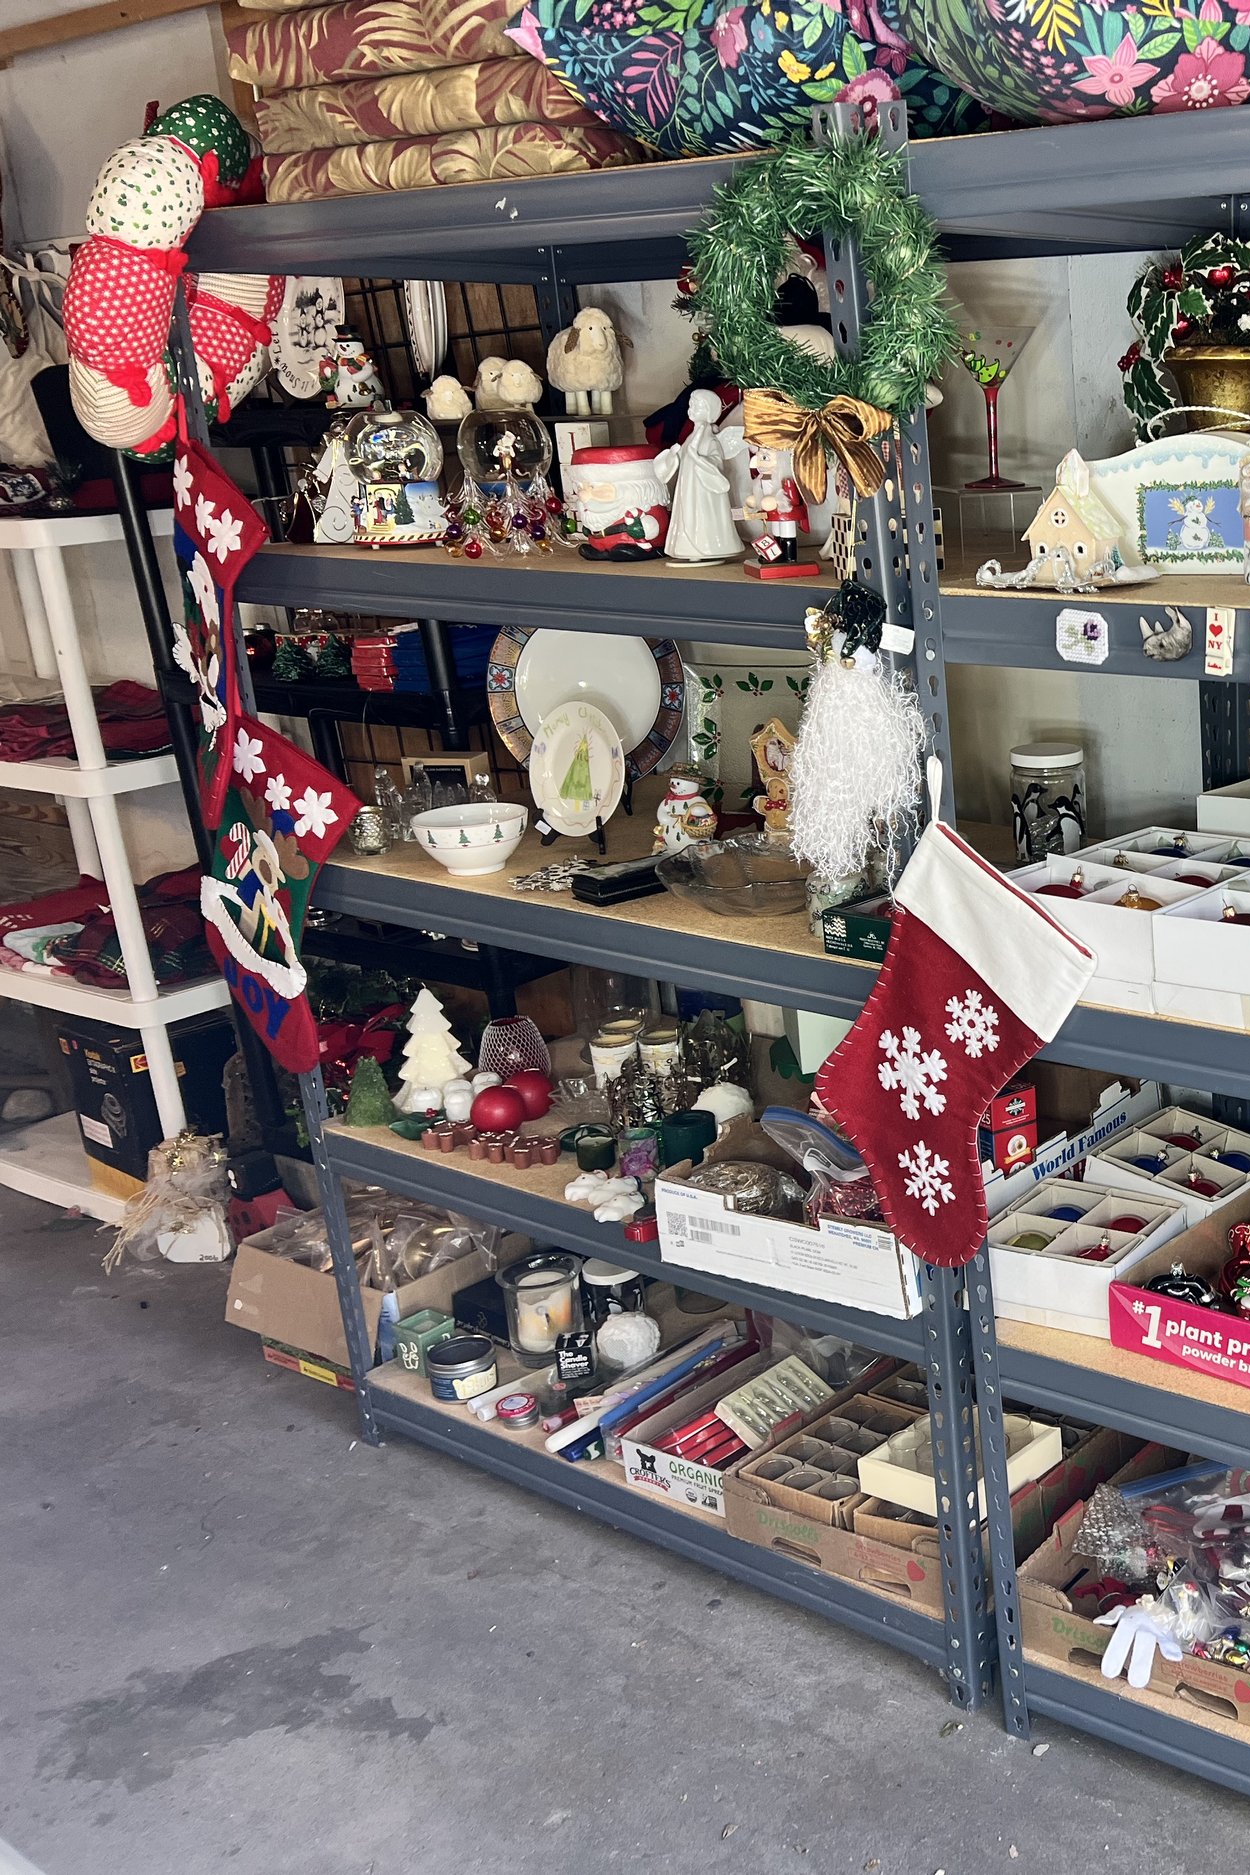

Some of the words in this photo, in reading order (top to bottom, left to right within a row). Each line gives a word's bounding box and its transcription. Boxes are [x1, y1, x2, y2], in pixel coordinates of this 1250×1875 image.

[1214, 612, 1219, 622] I
[1208, 640, 1223, 650] NY
[223, 955, 292, 1040] JOY
[1032, 1142, 1075, 1181] World
[1077, 1111, 1127, 1154] Famous
[1132, 1300, 1162, 1349] #1
[1165, 1319, 1223, 1349] plant
[558, 1350, 573, 1358] The
[559, 1354, 588, 1363] Candle
[1182, 1344, 1237, 1369] powder
[560, 1361, 589, 1370] Shaver
[671, 1474, 693, 1486] PREMIUM
[693, 1482, 707, 1491] FRUIT
[708, 1487, 723, 1496] SPREA
